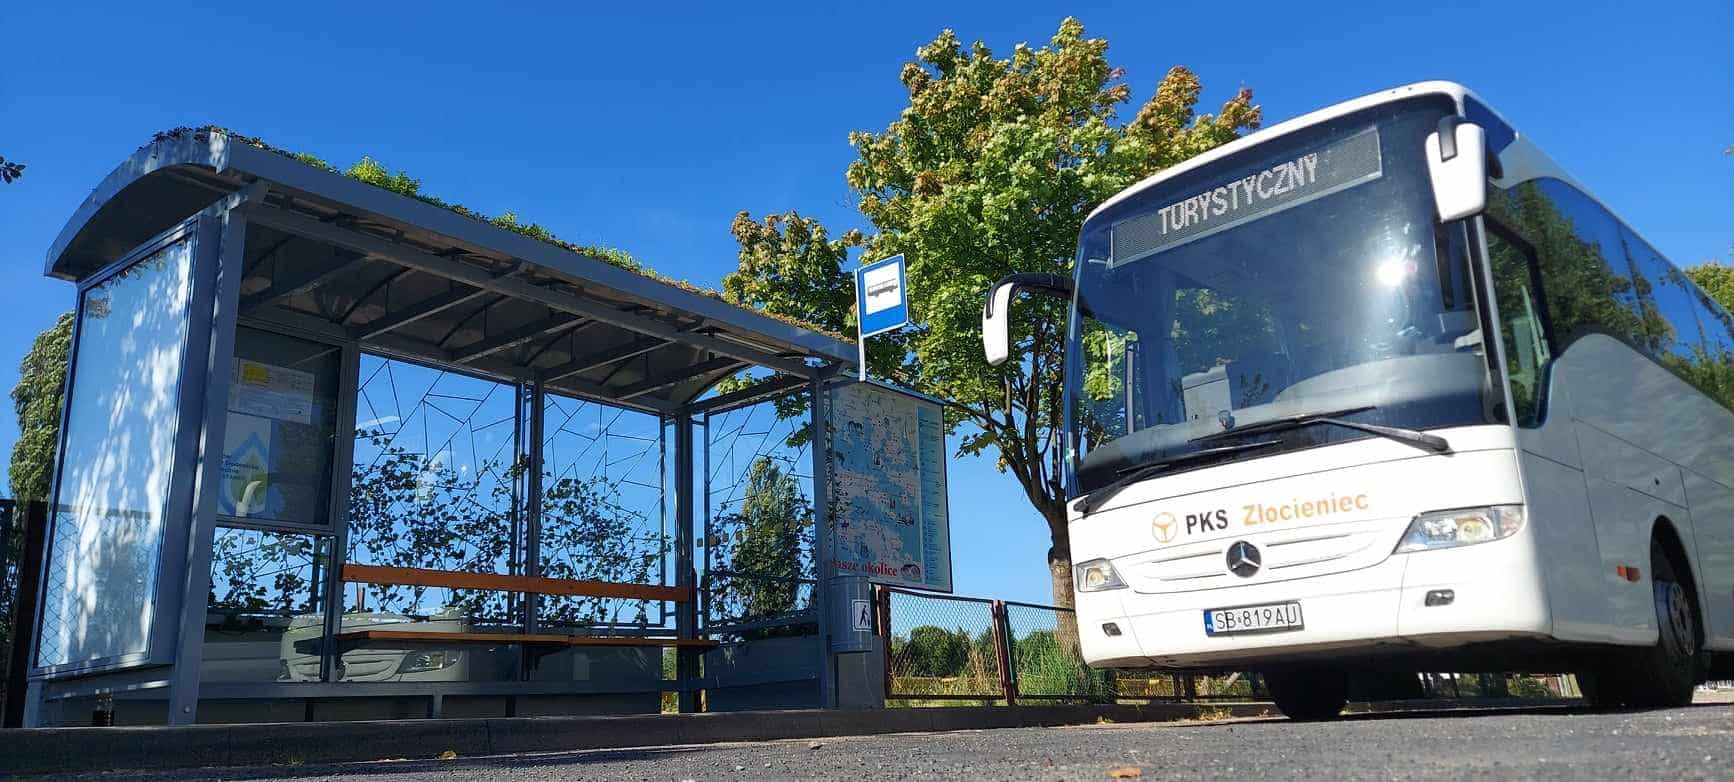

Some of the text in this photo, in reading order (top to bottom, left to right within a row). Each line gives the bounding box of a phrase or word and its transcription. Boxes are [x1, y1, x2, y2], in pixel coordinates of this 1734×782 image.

[1158, 153, 1319, 234] TURYSTYCZNY
[1186, 509, 1229, 535] PKS
[863, 559, 898, 576] okolice
